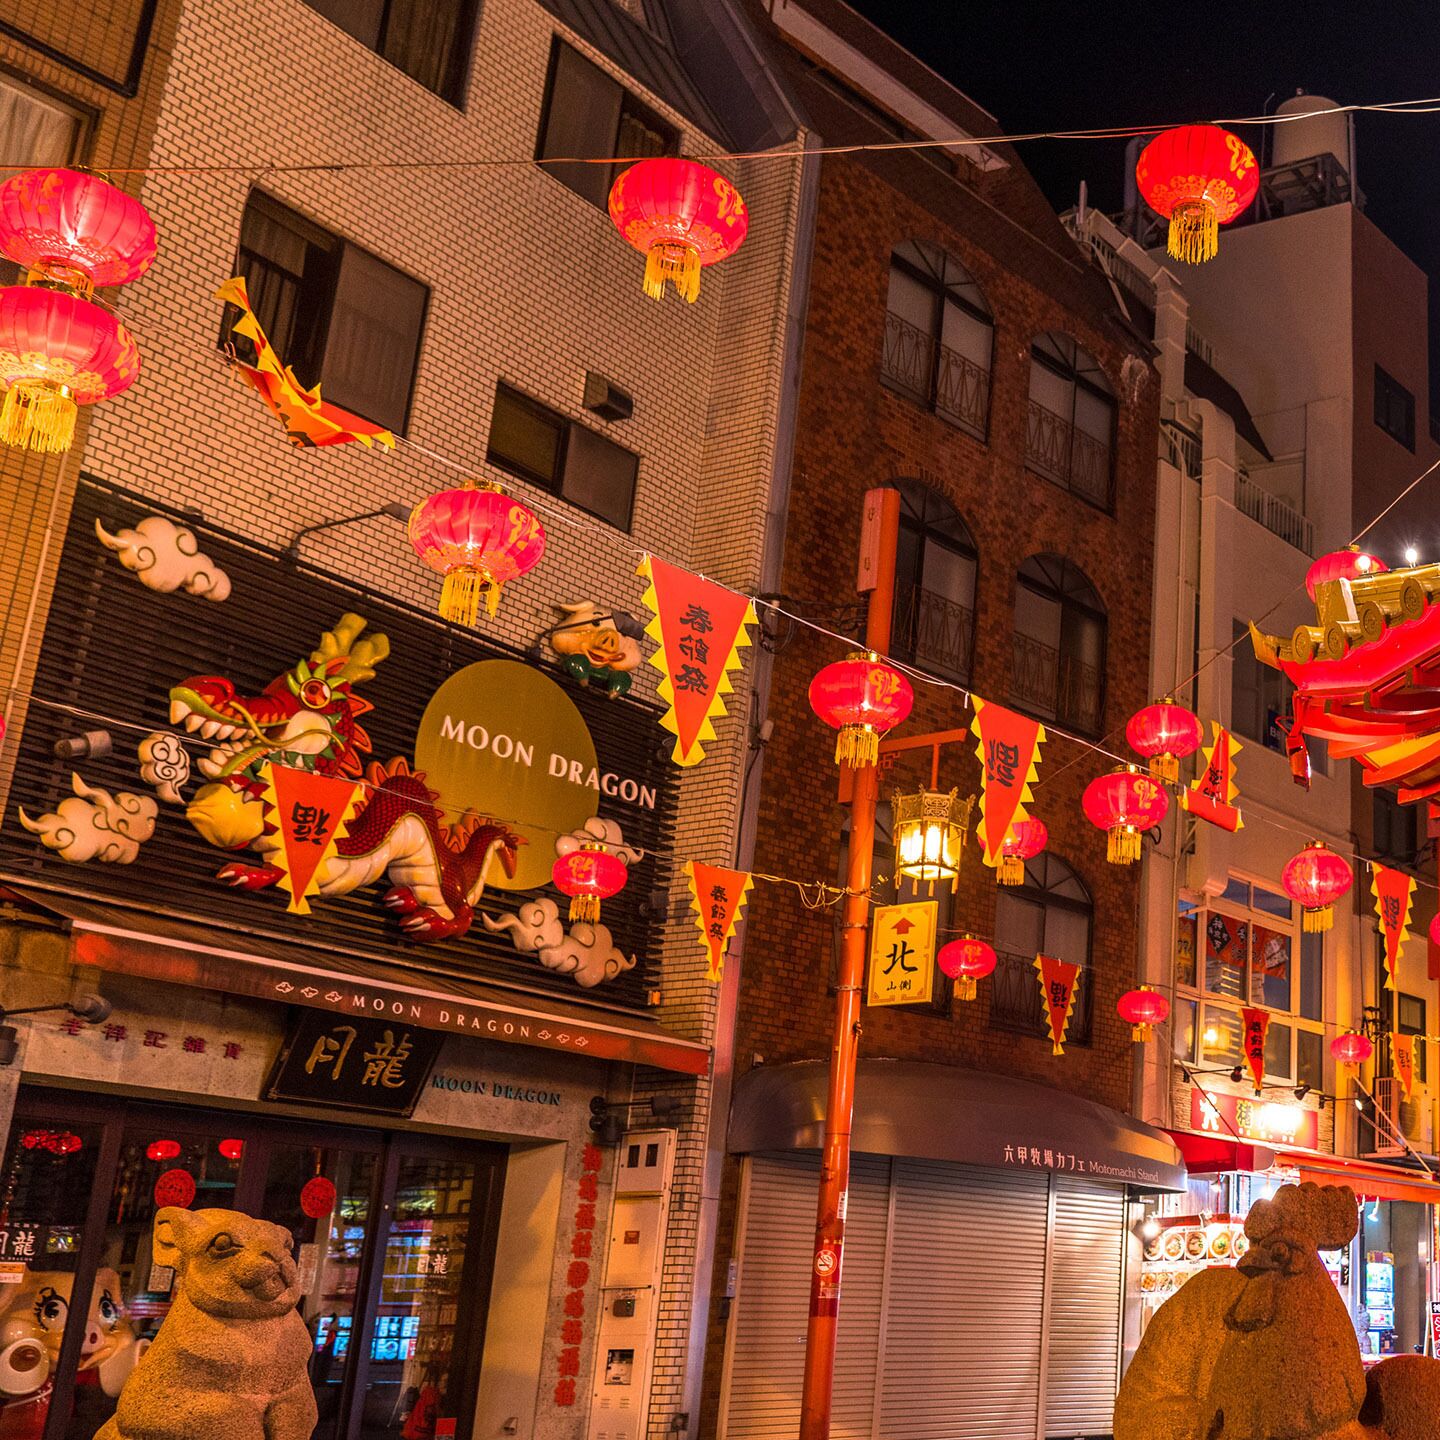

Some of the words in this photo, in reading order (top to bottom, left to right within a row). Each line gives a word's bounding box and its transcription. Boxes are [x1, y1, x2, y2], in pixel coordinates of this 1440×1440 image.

[868, 669, 901, 705] 福
[440, 714, 534, 767] MOON
[549, 752, 657, 810] DRAGON
[1134, 777, 1164, 811] 福
[291, 801, 331, 846] 福
[709, 885, 729, 941] 春節祭
[882, 939, 919, 975] 北
[886, 979, 912, 992] 山側
[351, 994, 422, 1018] MOON
[439, 1010, 530, 1038] DRAGON
[304, 1025, 414, 1089] 月龍
[432, 1075, 487, 1096] MOON
[492, 1080, 562, 1107] DRAGON
[1003, 1144, 1086, 1173] 六甲牧場カフェ
[1088, 1160, 1137, 1179] Motomachi
[1137, 1168, 1159, 1183] Stand
